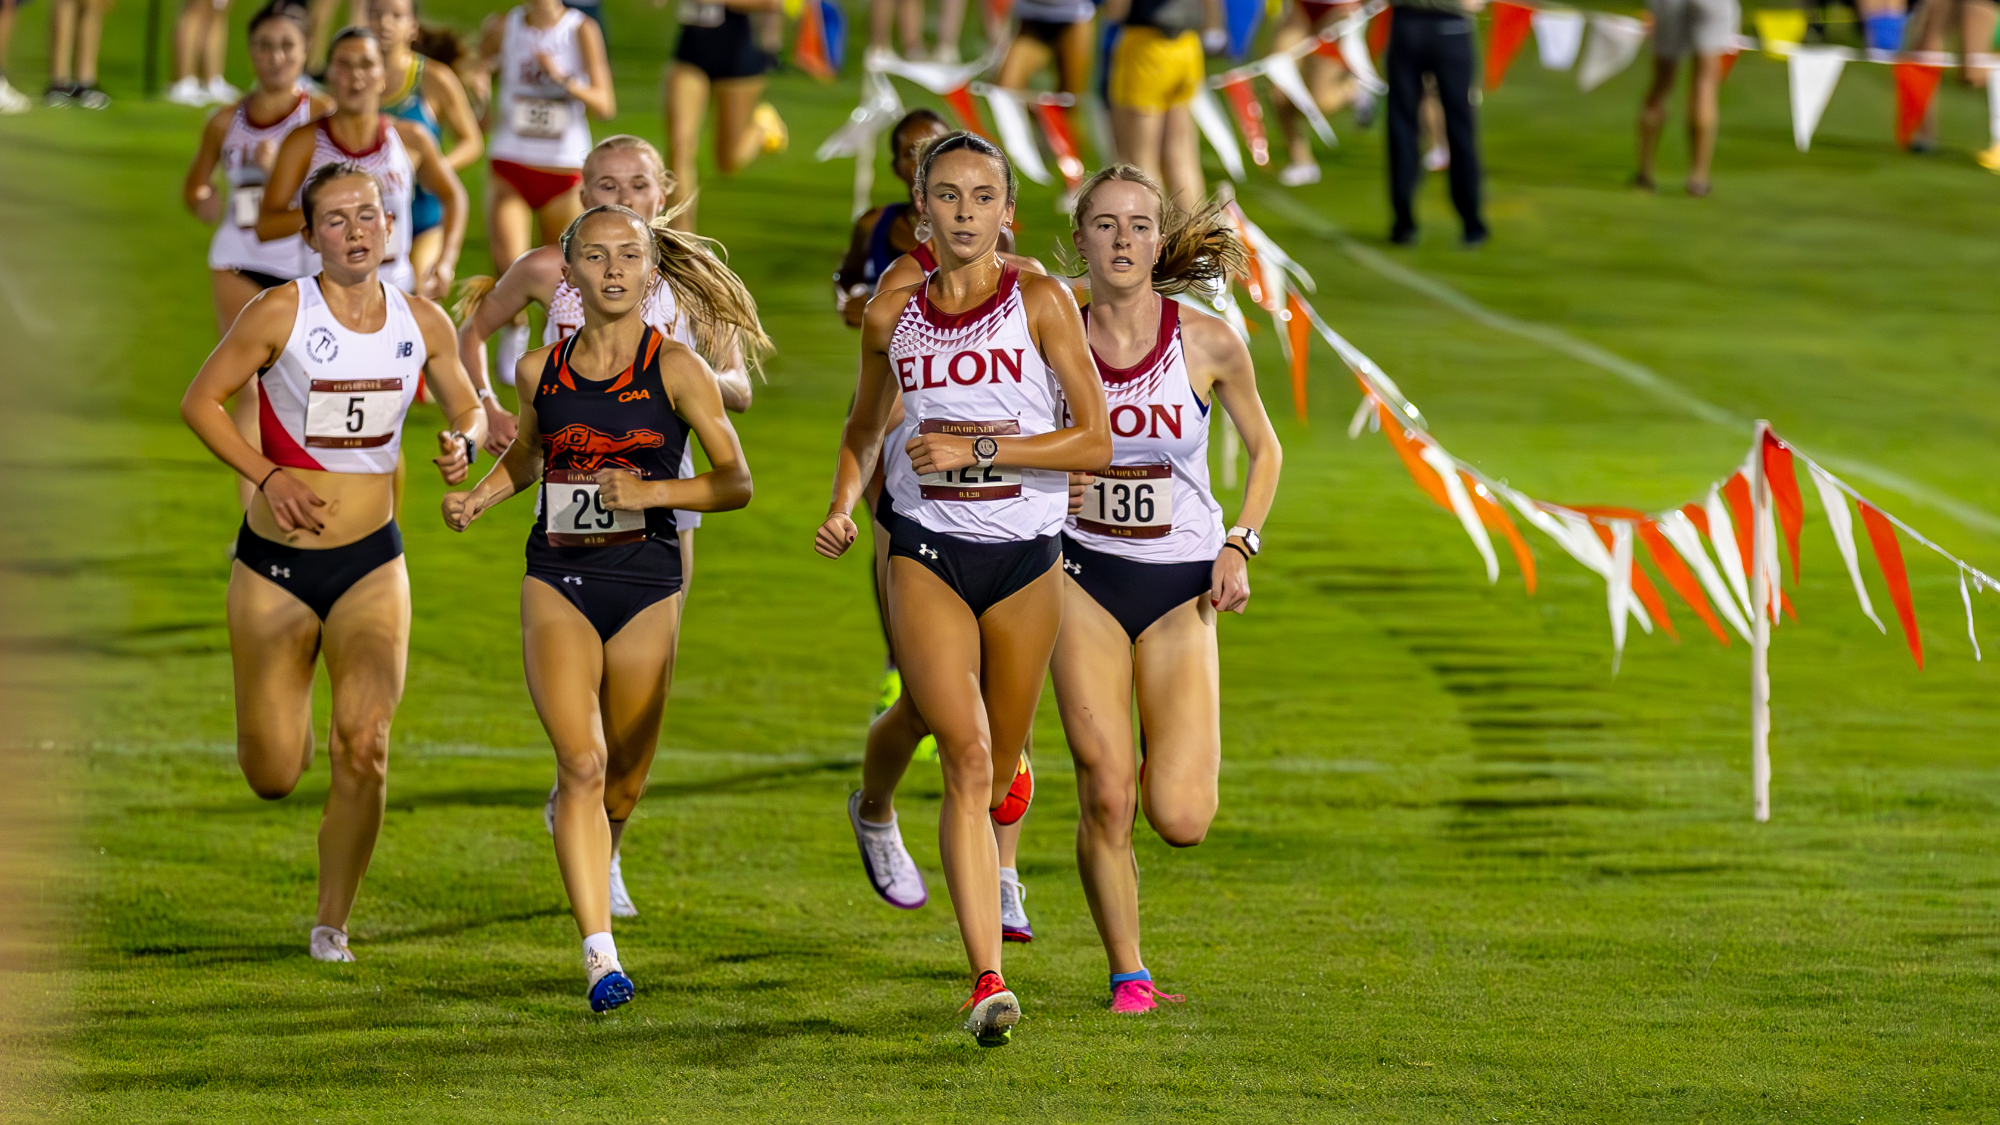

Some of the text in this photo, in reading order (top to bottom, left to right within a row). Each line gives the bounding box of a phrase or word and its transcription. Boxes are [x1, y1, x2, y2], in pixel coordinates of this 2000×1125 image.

[895, 348, 1026, 394] ELON
[346, 396, 365, 433] 5
[618, 389, 650, 402] CAA
[942, 425, 995, 433] ELON OPENER
[572, 489, 615, 529] 29
[1093, 482, 1154, 522] 136
